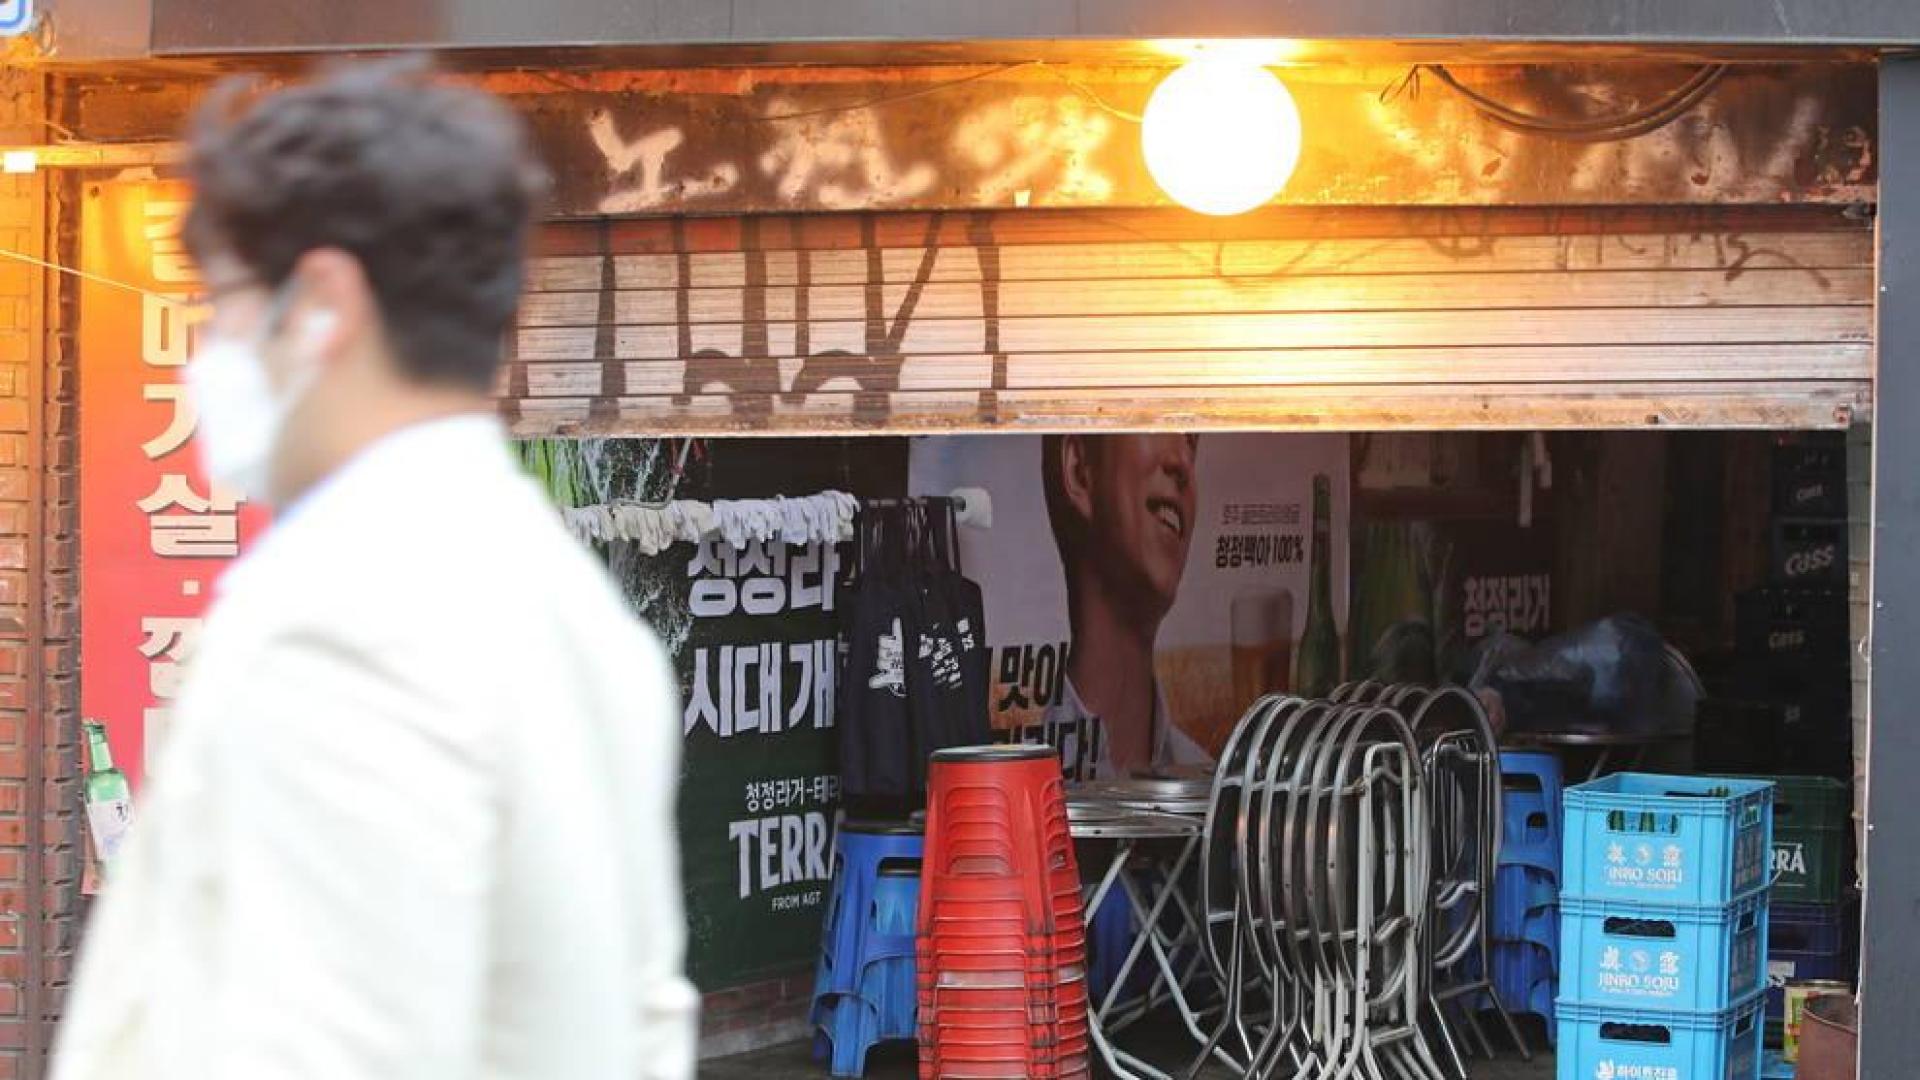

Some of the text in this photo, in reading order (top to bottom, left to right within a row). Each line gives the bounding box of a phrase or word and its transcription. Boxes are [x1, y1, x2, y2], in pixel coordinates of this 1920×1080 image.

[688, 538, 839, 618] 청정라
[683, 640, 783, 738] 시대
[788, 639, 836, 729] 개
[998, 641, 1068, 712] 맛이
